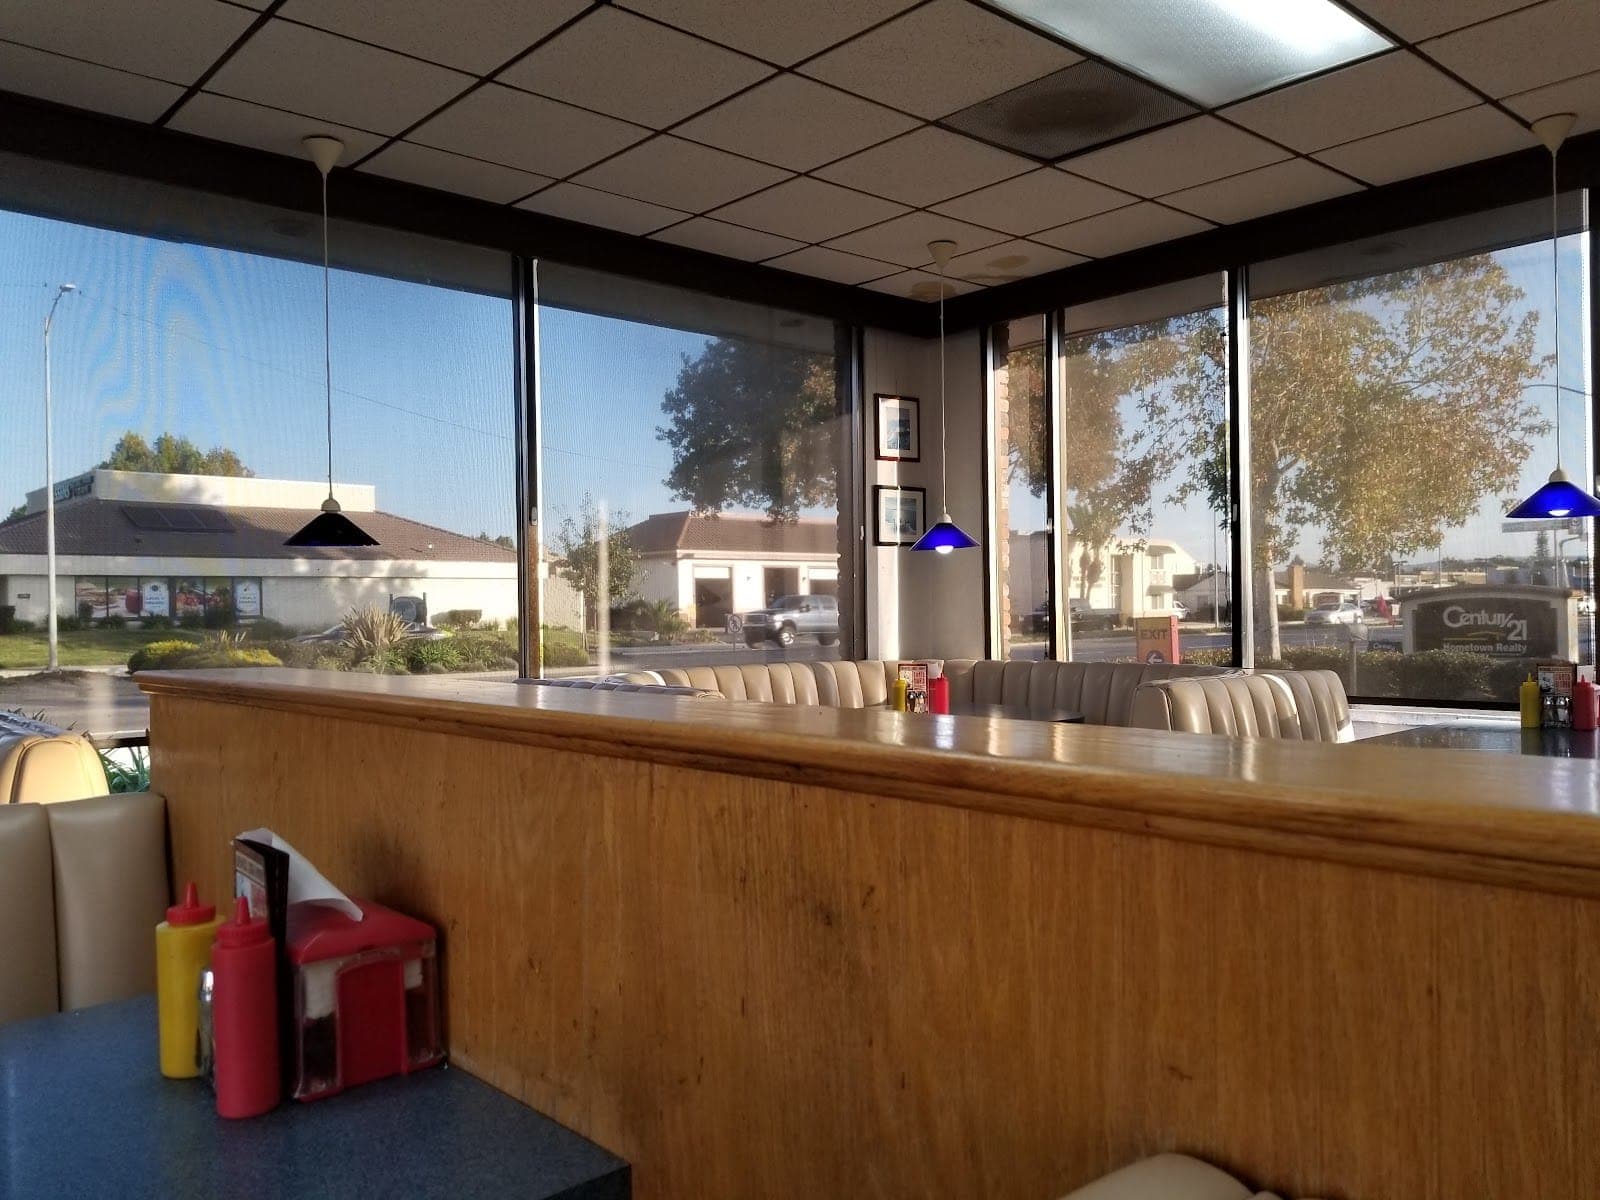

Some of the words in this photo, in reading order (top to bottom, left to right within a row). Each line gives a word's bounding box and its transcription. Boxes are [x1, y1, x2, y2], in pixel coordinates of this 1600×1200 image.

[1443, 606, 1514, 628] Century
[1506, 620, 1528, 641] 21
[1140, 630, 1168, 640] EXIT
[1443, 643, 1493, 652] Hometown
[1496, 643, 1527, 654] Realty
